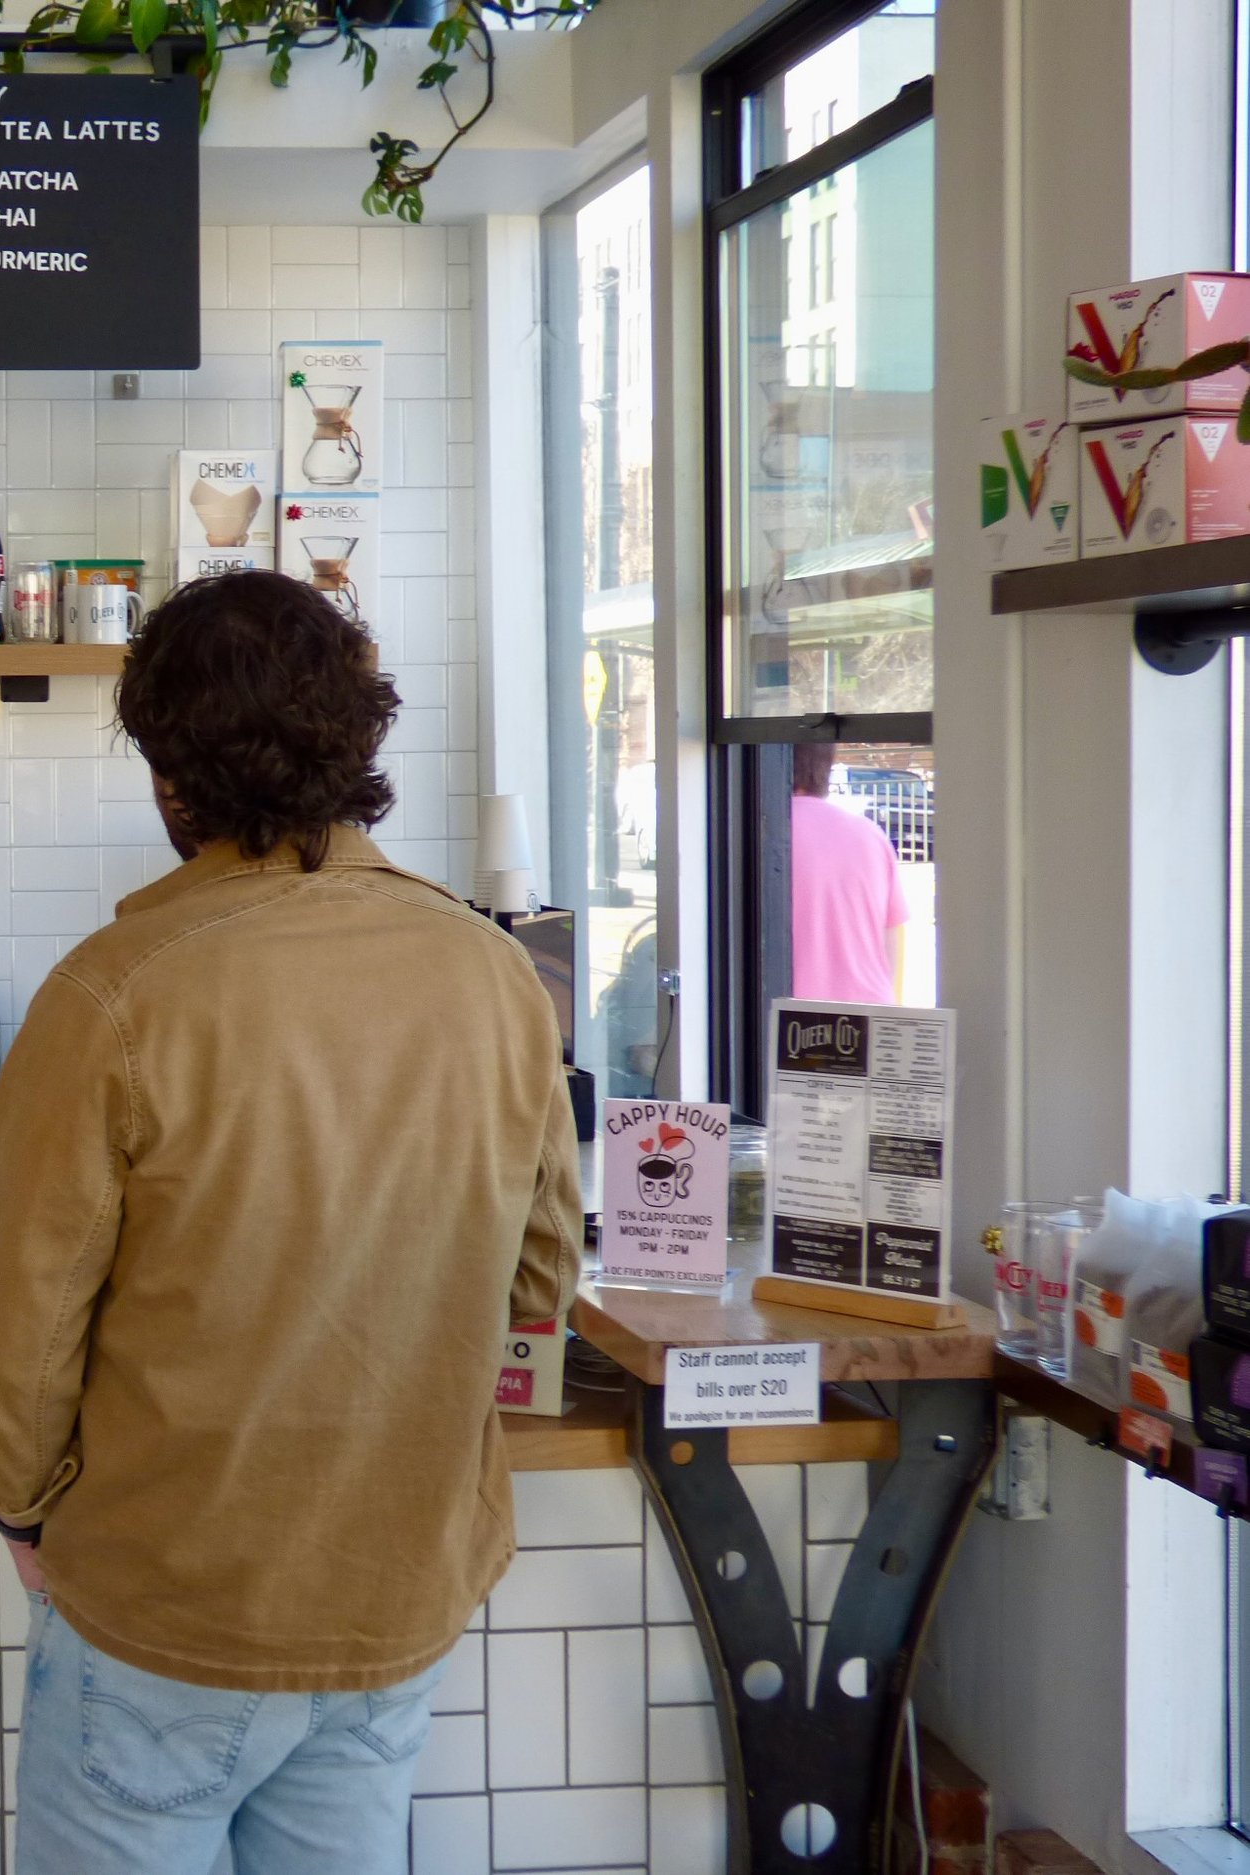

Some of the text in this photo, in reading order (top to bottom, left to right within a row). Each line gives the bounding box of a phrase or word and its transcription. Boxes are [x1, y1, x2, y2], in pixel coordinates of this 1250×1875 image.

[0, 121, 159, 141] TEA LATTES
[1201, 285, 1217, 297] 02
[303, 355, 362, 367] CHEMEX
[1201, 427, 1219, 439] 02
[199, 463, 256, 479] CHEMEX
[302, 506, 358, 518] CHEMEX
[788, 1021, 832, 1059] QUEEN
[835, 1016, 860, 1055] CITY
[607, 1104, 728, 1140] CAPPY HOUR
[617, 1210, 713, 1226] 15% CAPPUCCINOS
[620, 1225, 662, 1237] MONDAY
[672, 1230, 709, 1241] FRIDAY
[638, 1242, 658, 1252] 1PM
[667, 1244, 689, 1255] 2PM
[624, 1267, 642, 1277] FIVE
[645, 1269, 675, 1279] POINTS
[677, 1271, 724, 1283] EXCLUSIVE
[679, 1350, 806, 1367] Staff cannot accept
[697, 1382, 723, 1397] bills
[729, 1384, 756, 1397] over
[670, 1408, 814, 1422] We apologize for any inconvenience
